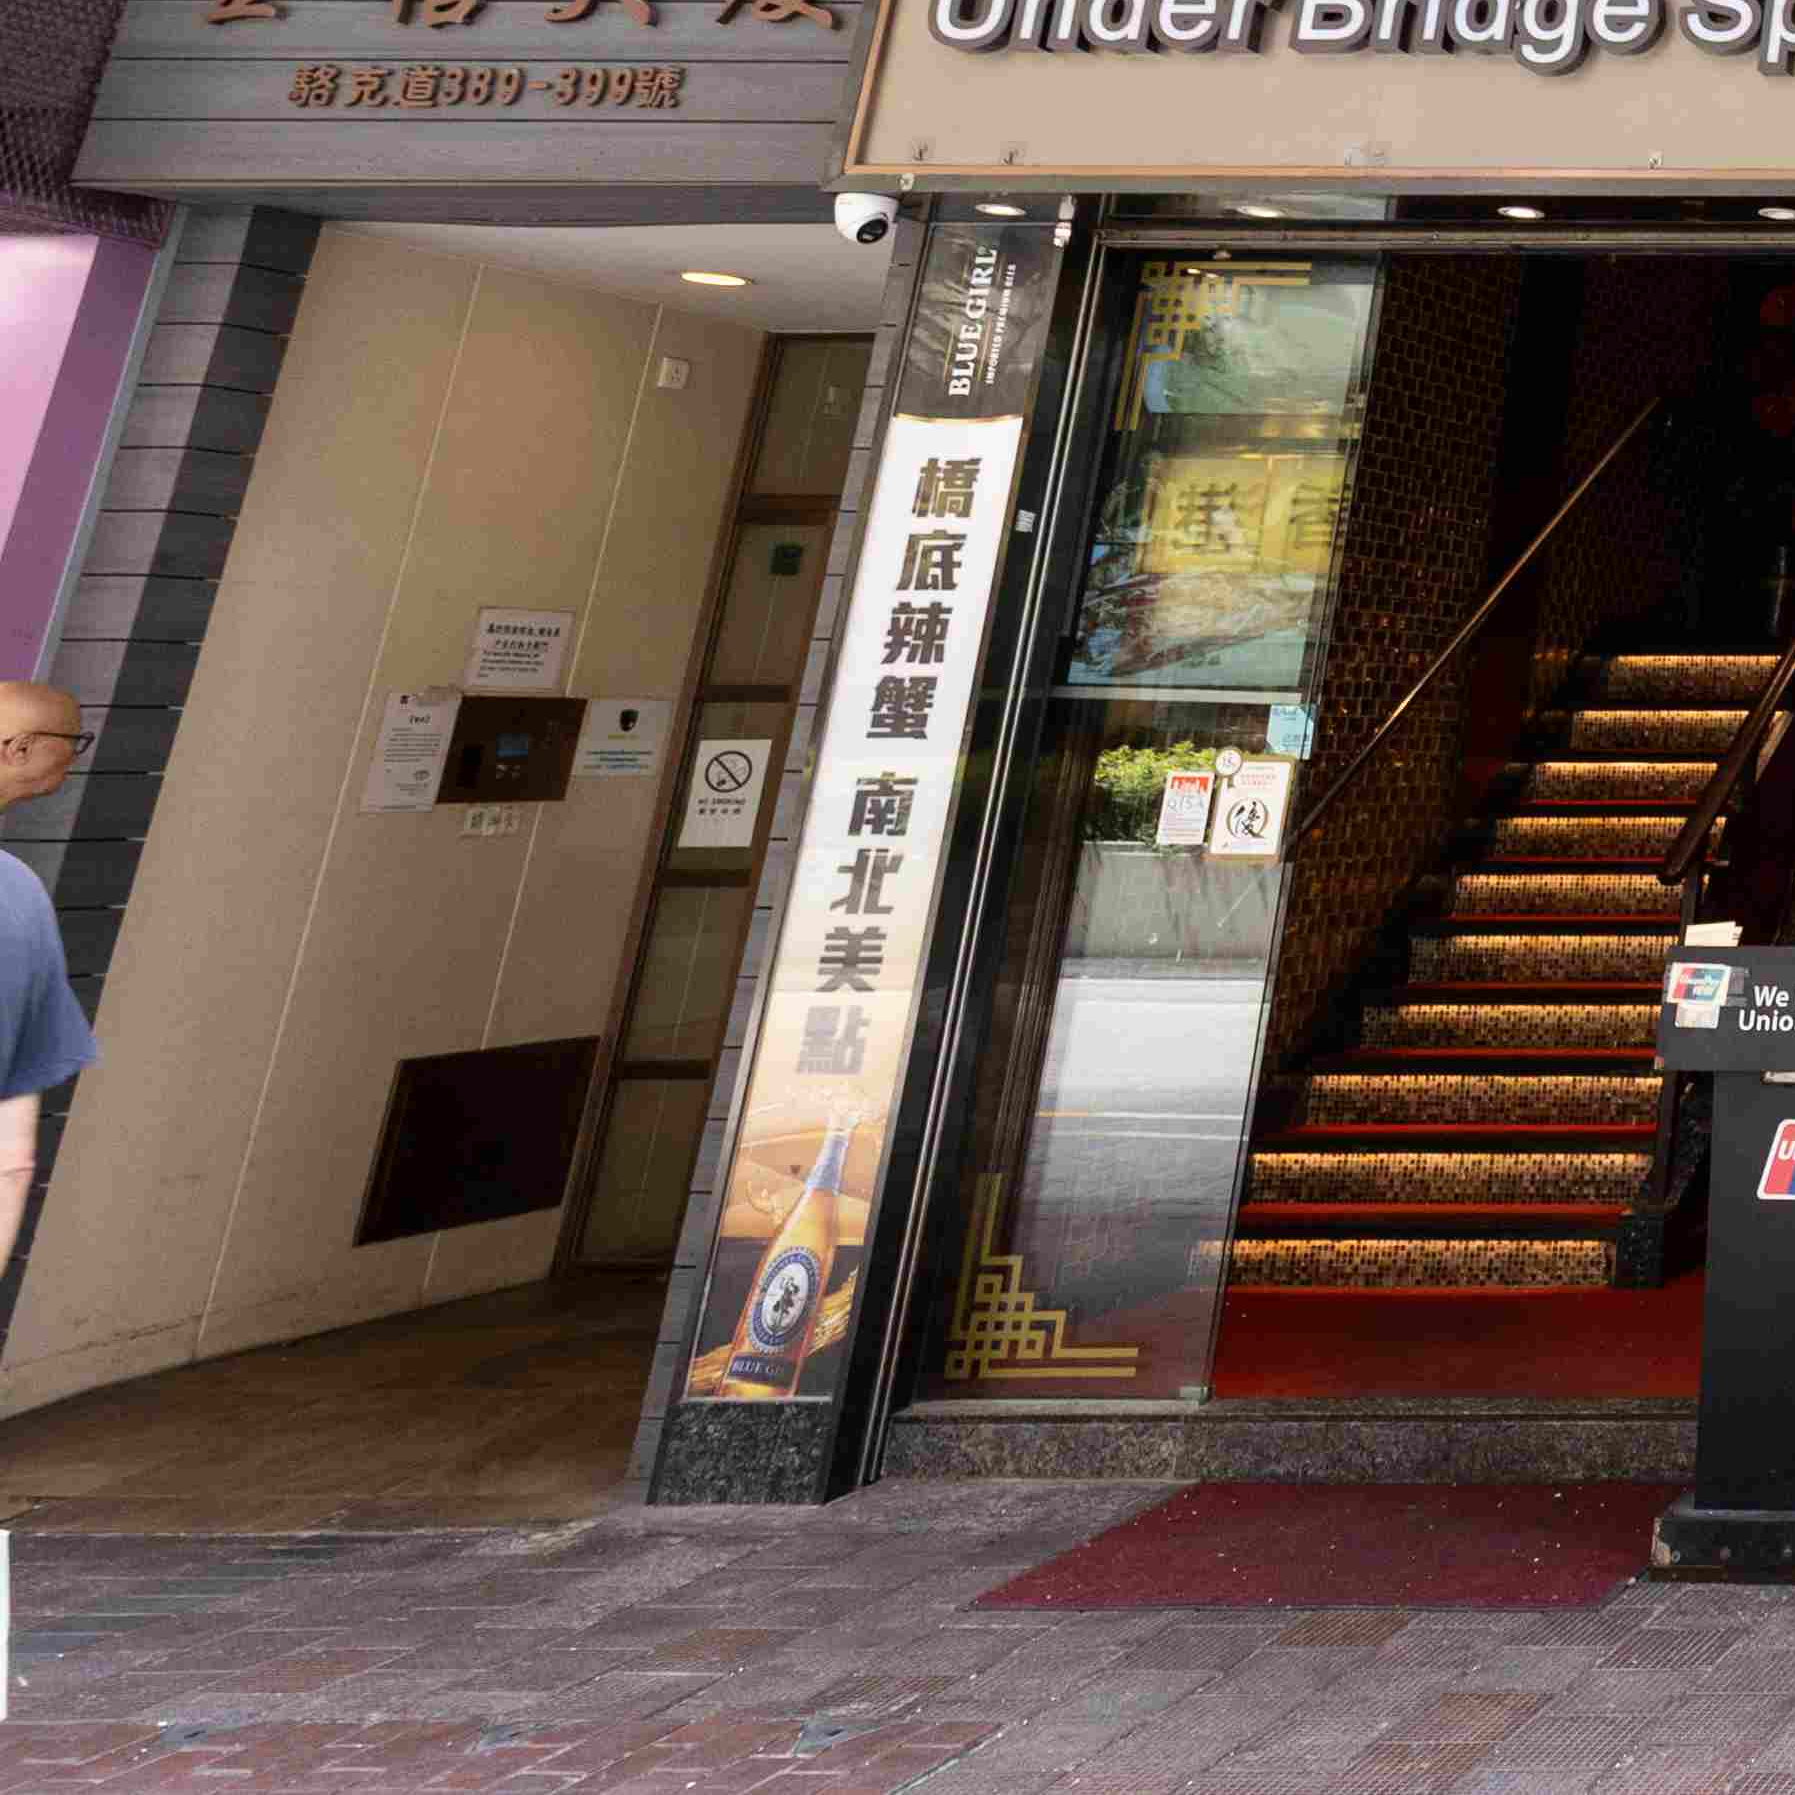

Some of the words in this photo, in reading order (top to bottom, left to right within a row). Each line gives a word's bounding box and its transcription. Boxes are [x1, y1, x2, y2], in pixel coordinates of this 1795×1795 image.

[288, 63, 685, 110] 駱克道389-399號
[949, 322, 983, 397] BLUE
[966, 246, 998, 320] GIRL
[865, 457, 982, 740] 橋底辣蟹
[795, 771, 918, 1076] 南北美點
[1754, 985, 1790, 1008] We
